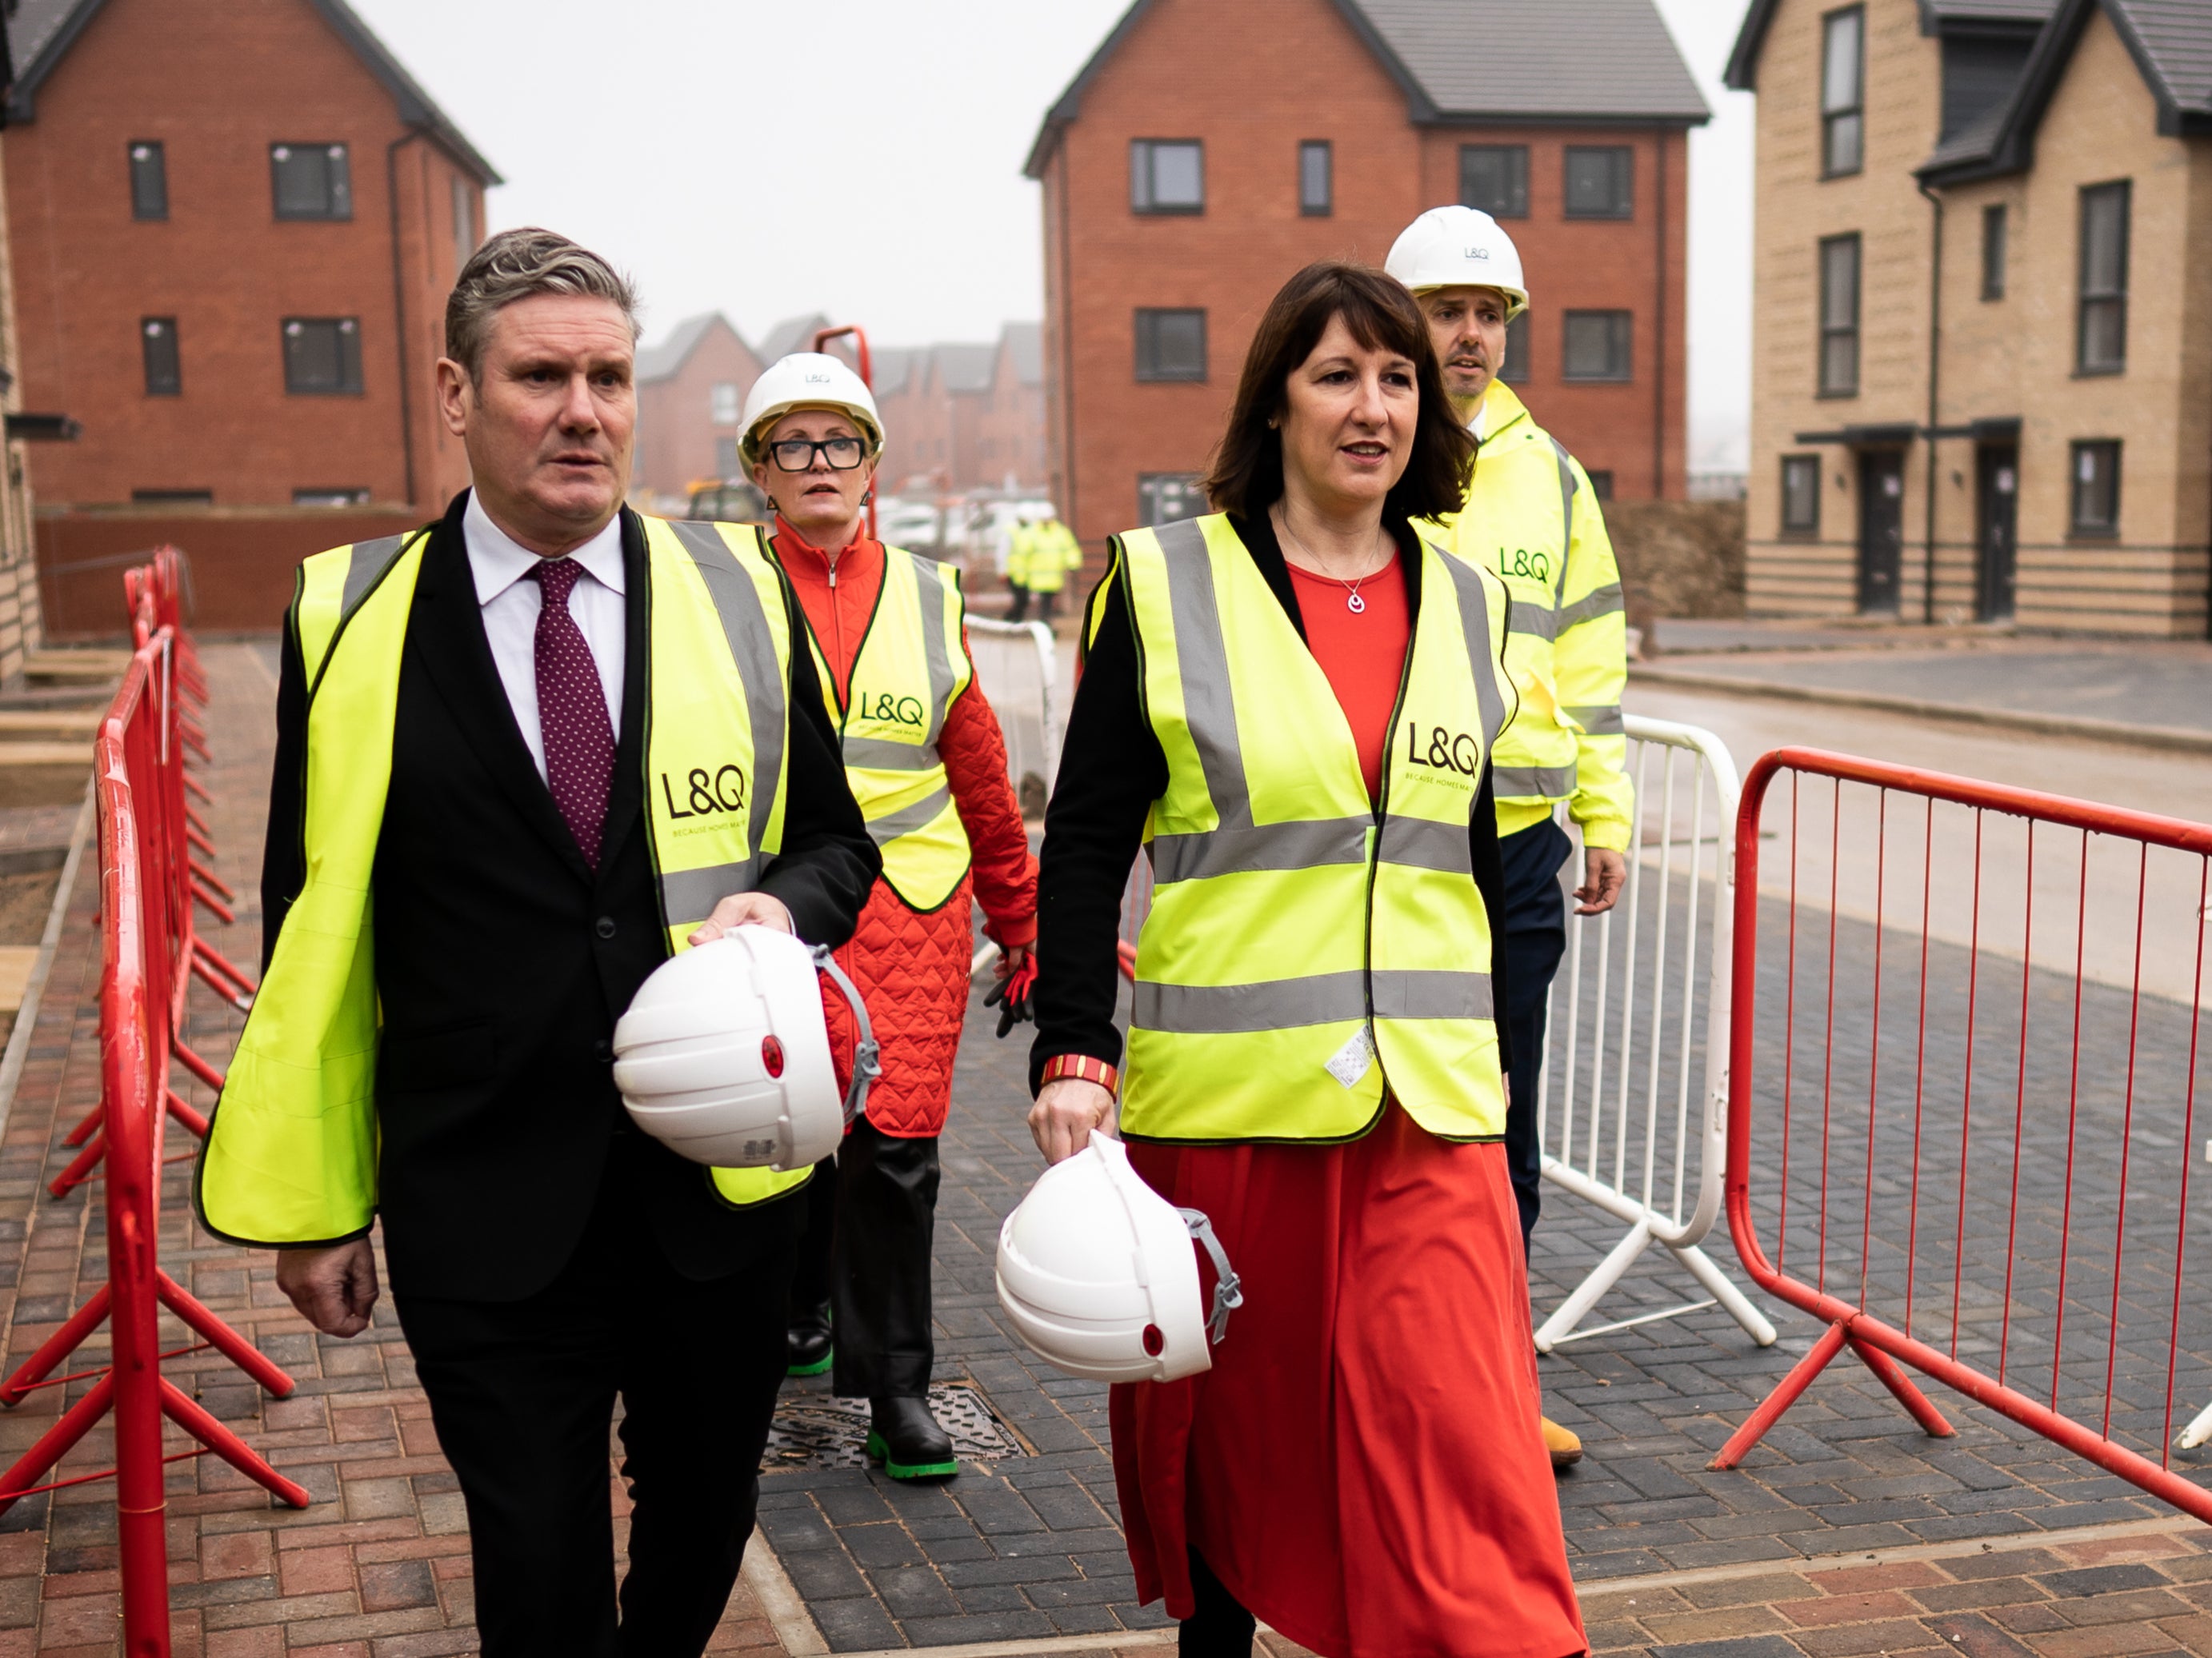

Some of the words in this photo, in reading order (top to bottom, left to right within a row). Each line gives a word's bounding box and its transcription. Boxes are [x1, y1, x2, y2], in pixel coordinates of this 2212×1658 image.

[1464, 247, 1489, 260] L&Q
[1500, 547, 1549, 584] L&Q
[861, 692, 923, 727] L&Q
[1409, 722, 1478, 779] L&Q
[662, 764, 744, 819] L&Q
[1405, 773, 1434, 784] BECAUSE
[1436, 779, 1458, 789] HOMES
[672, 825, 706, 837] BECAUSE
